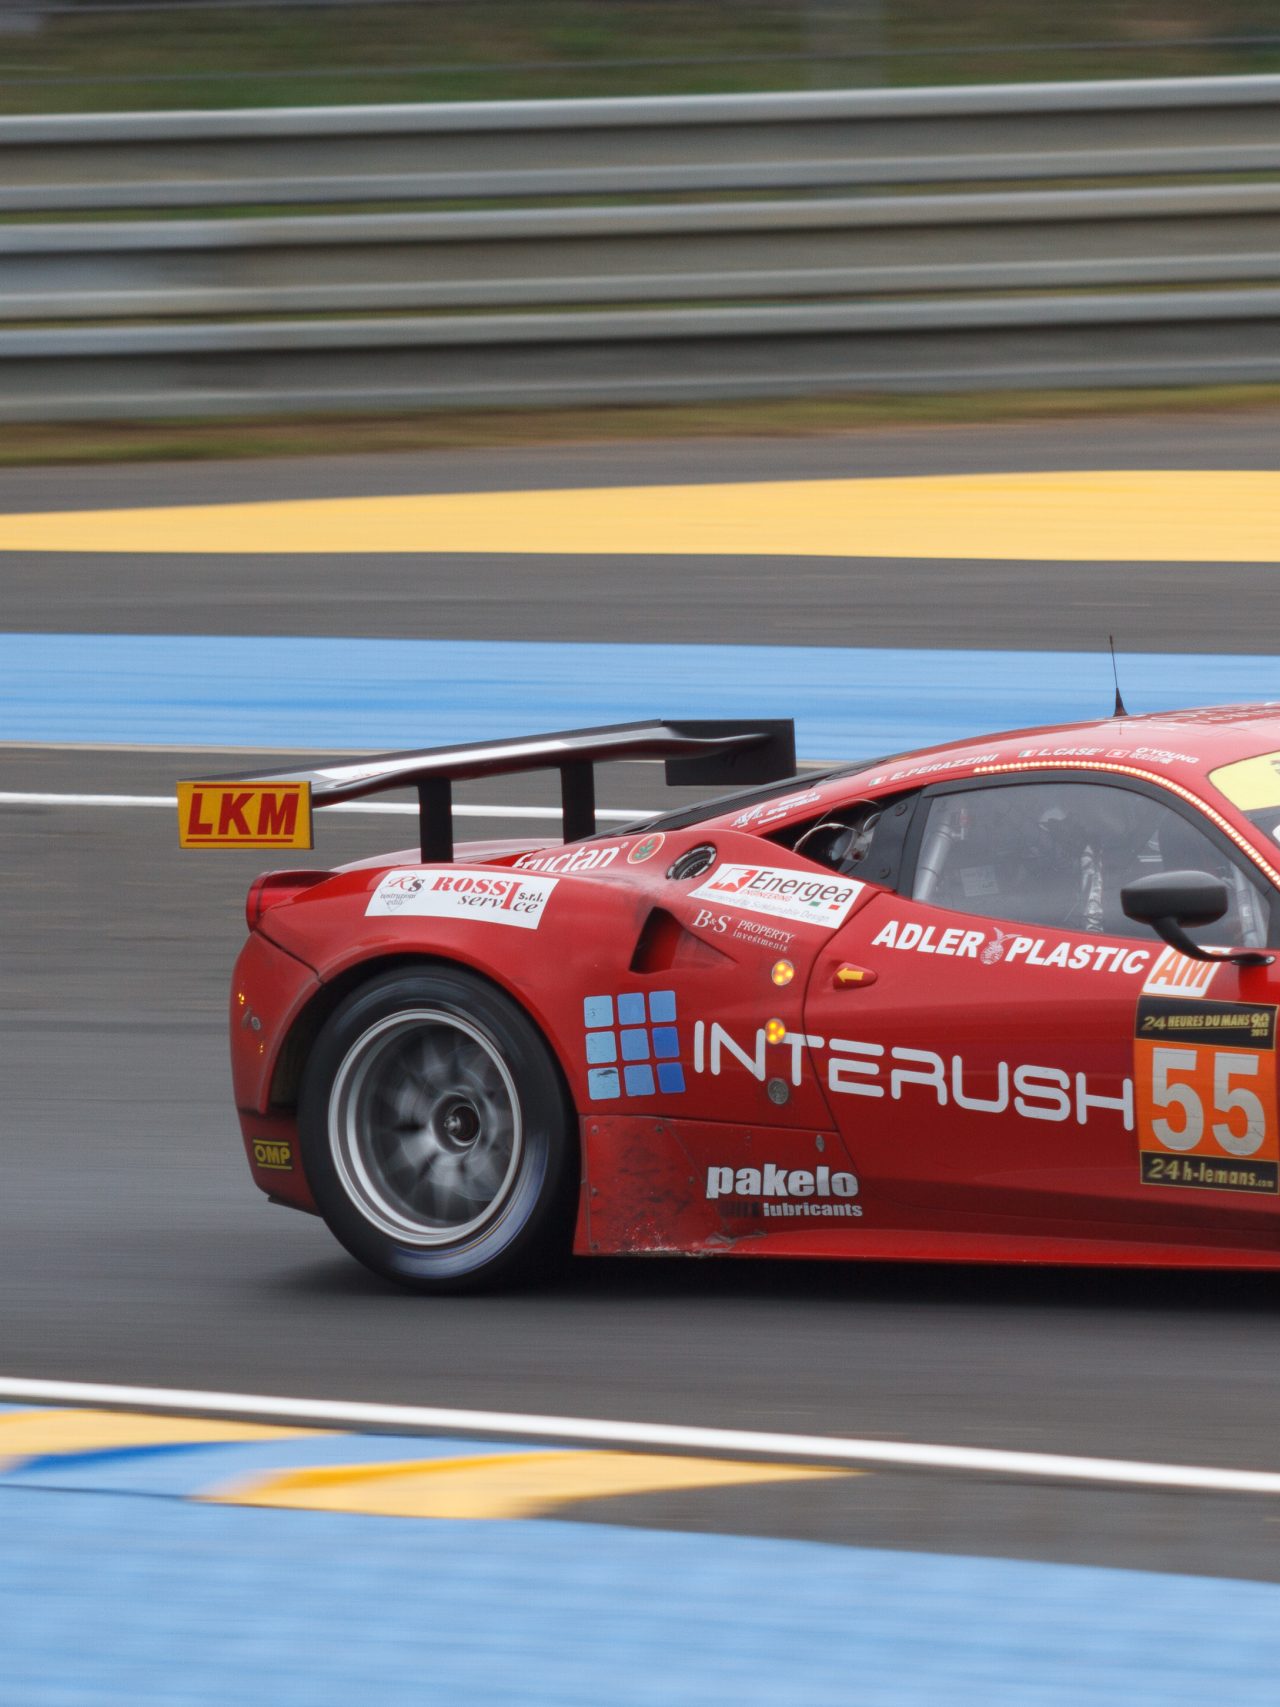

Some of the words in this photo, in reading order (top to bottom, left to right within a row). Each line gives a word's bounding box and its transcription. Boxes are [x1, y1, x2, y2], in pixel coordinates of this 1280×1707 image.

[188, 793, 300, 835] LKM
[431, 876, 523, 910] ROSSI
[748, 871, 854, 903] Energea
[692, 909, 732, 934] B&S
[737, 919, 795, 944] PROPERTY
[733, 930, 788, 953] investments
[871, 920, 985, 959] ADLER
[1004, 936, 1150, 975] PLASTIC
[1151, 950, 1217, 988] AM
[1141, 1016, 1167, 1032] 24
[1167, 1014, 1204, 1028] HEURES
[1205, 1014, 1219, 1027] DU
[1221, 1013, 1250, 1027] MANS
[693, 1020, 1134, 1131] INTERUSH
[1151, 1047, 1267, 1156] 55
[254, 1145, 291, 1164] OMP
[706, 1163, 859, 1199] pakelo
[763, 1203, 863, 1217] lubricants
